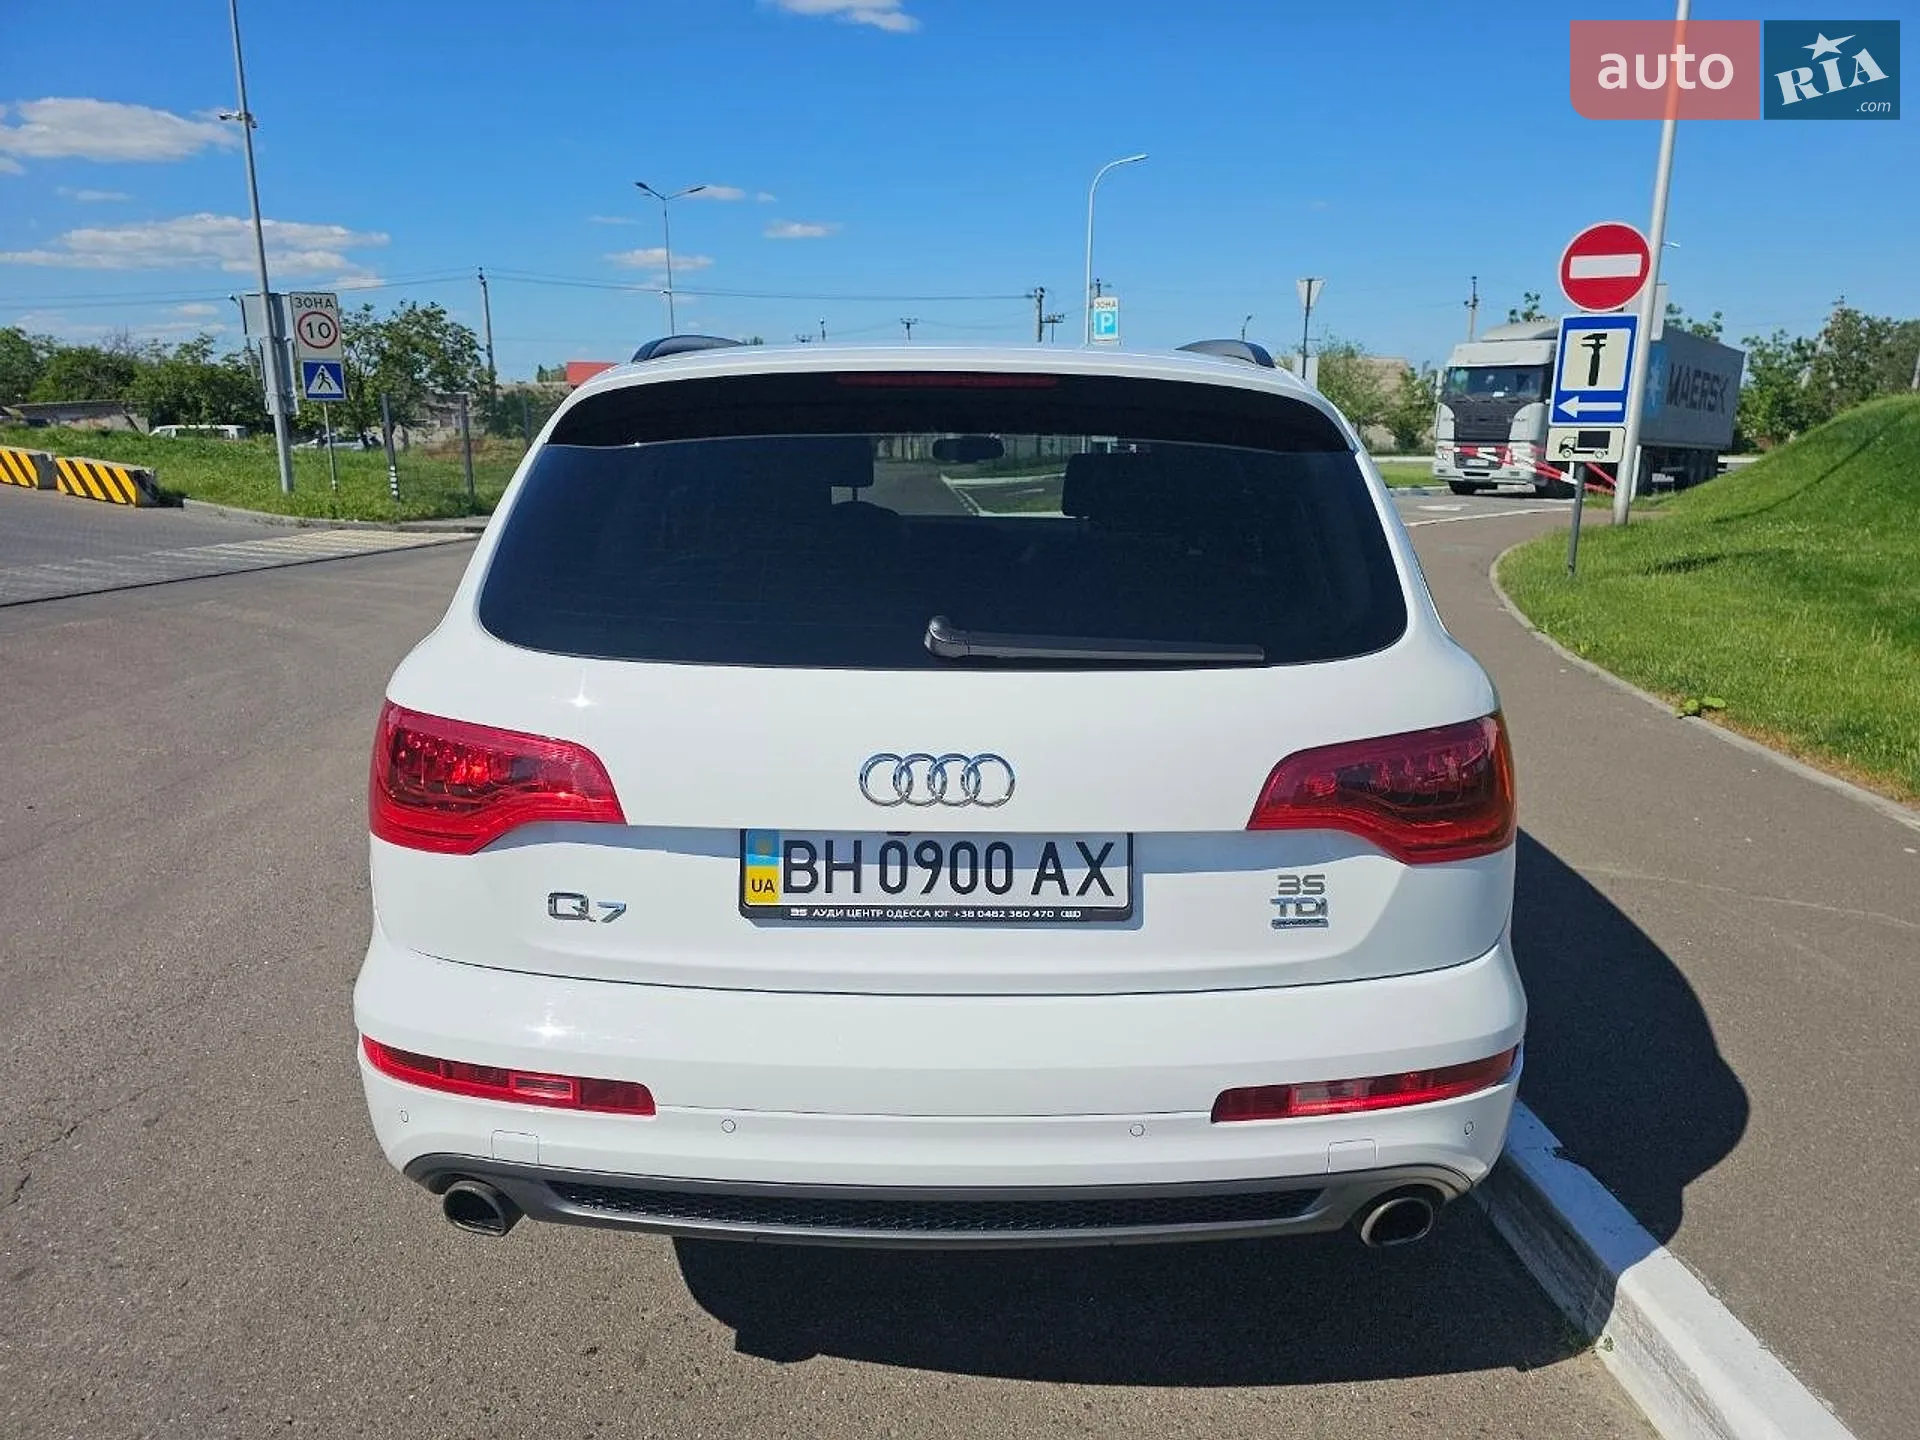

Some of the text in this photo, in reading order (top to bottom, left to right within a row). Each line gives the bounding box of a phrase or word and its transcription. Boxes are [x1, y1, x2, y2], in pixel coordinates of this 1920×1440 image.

[295, 297, 334, 309] ЗОНА
[306, 322, 332, 339] 10
[1101, 313, 1114, 332] P
[783, 840, 1115, 896] BH 0900 AX
[751, 879, 775, 893] UA
[547, 892, 627, 923] Q7
[812, 908, 843, 918] АУДИ
[846, 908, 884, 918] ЦЕНТР
[886, 909, 931, 919] ОДЕССА
